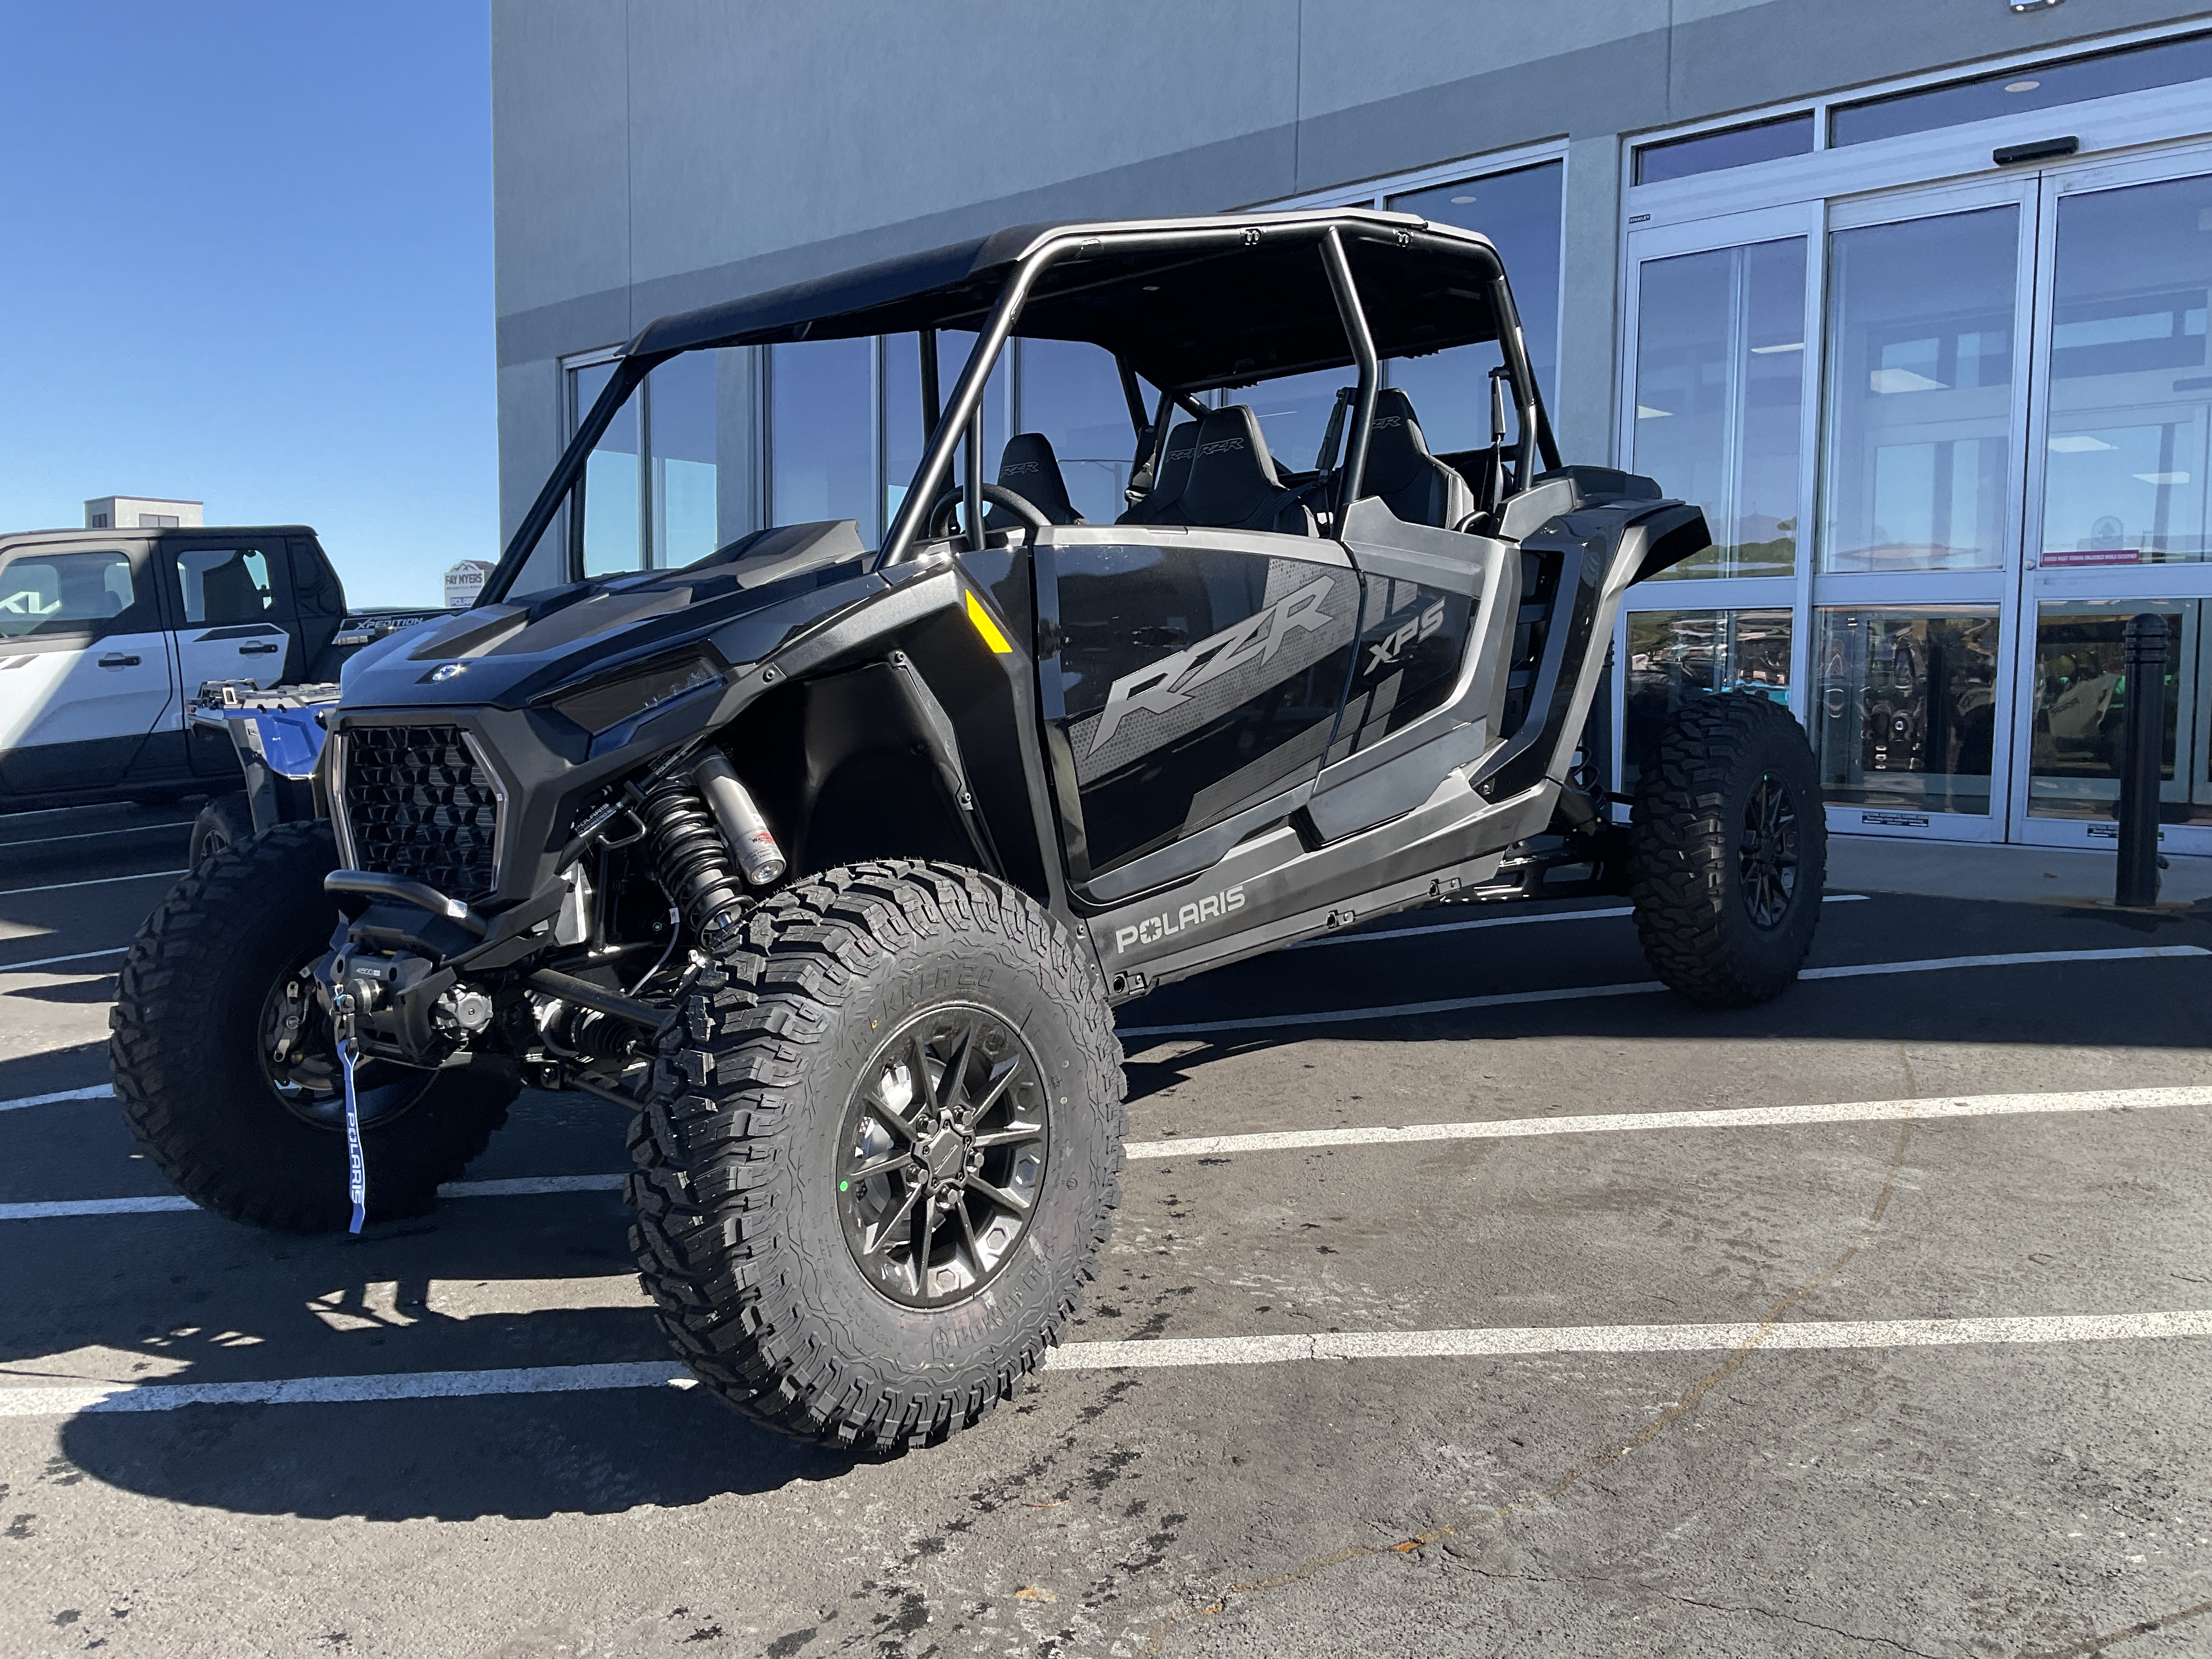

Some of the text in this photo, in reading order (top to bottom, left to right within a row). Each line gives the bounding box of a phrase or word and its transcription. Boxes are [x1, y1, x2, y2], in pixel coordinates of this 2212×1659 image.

[1372, 416, 1401, 430] ZR
[1197, 438, 1244, 459] RZR
[1000, 461, 1039, 479] RZR
[445, 573, 482, 585] FAY MYERS
[357, 617, 423, 630] XPEDITION
[1087, 575, 1335, 760] RZR
[574, 803, 610, 831] POLARIS
[1115, 885, 1245, 954] POLARIS
[347, 1112, 363, 1204] POLARIS
